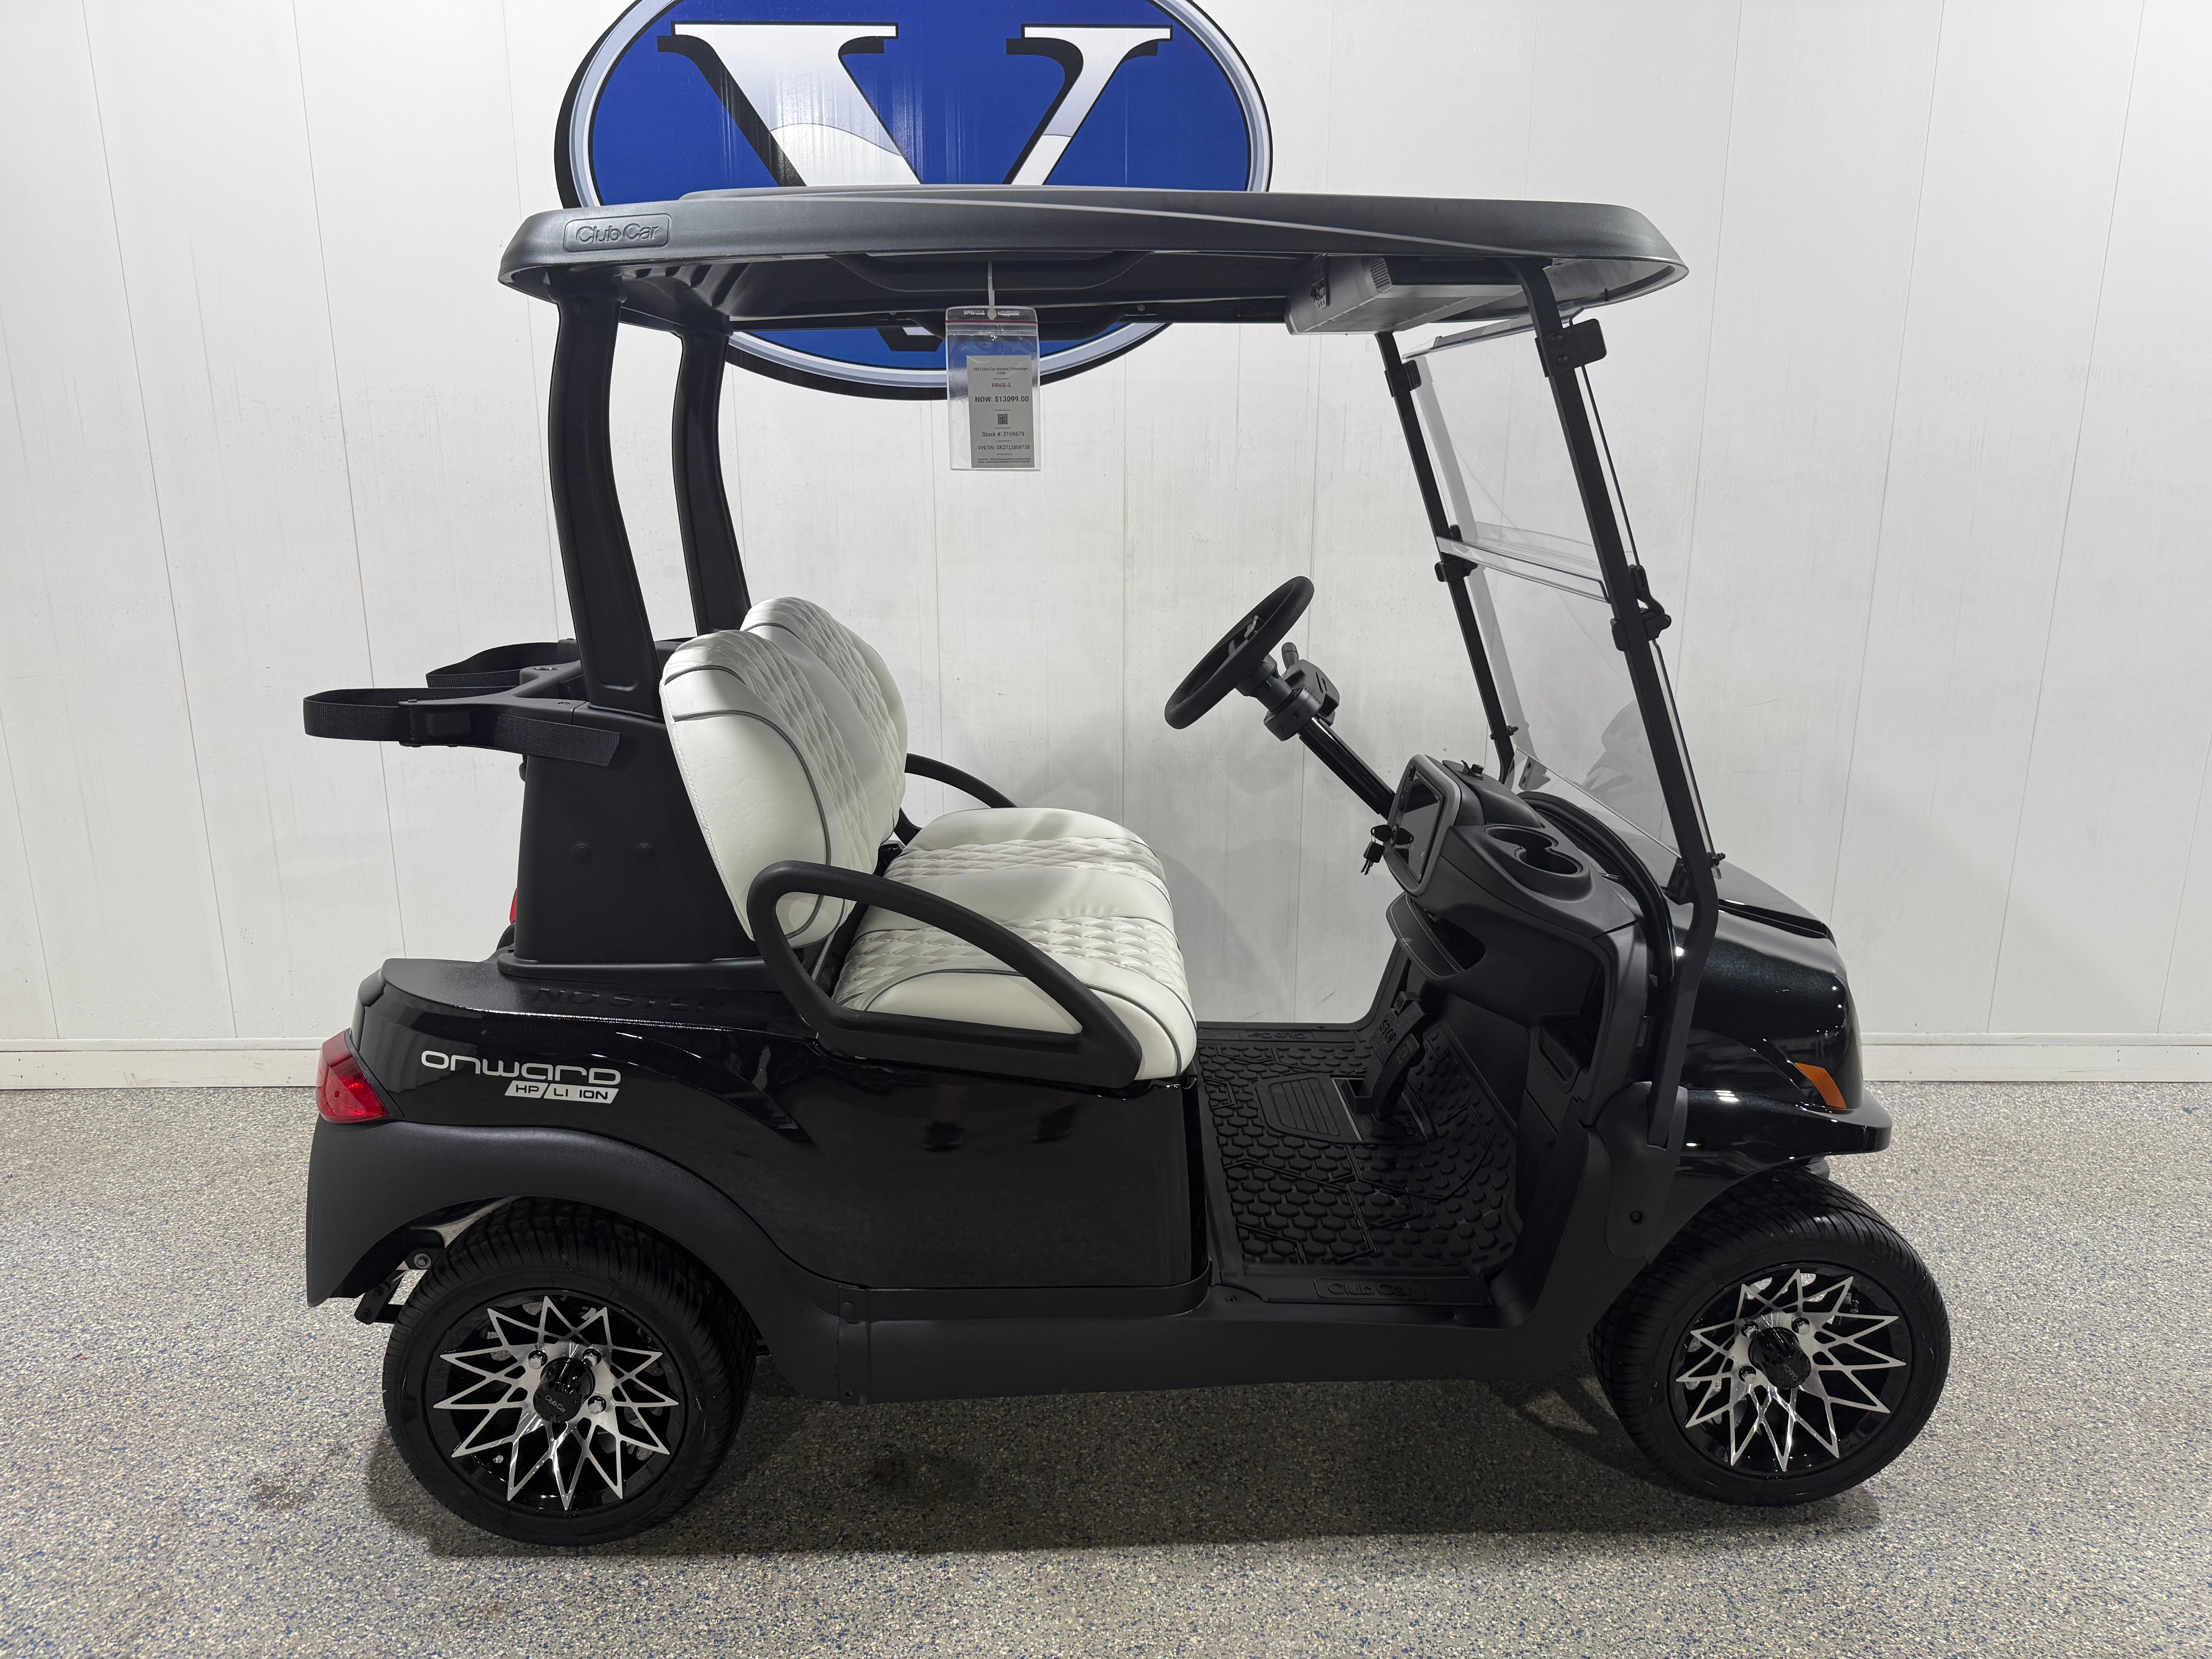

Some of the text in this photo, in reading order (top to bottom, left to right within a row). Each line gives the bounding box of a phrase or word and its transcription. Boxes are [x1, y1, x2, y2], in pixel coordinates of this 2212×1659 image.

[576, 223, 659, 244] Club Car
[516, 1085, 608, 1100] HP LI ION
[545, 1395, 567, 1412] Club Car
